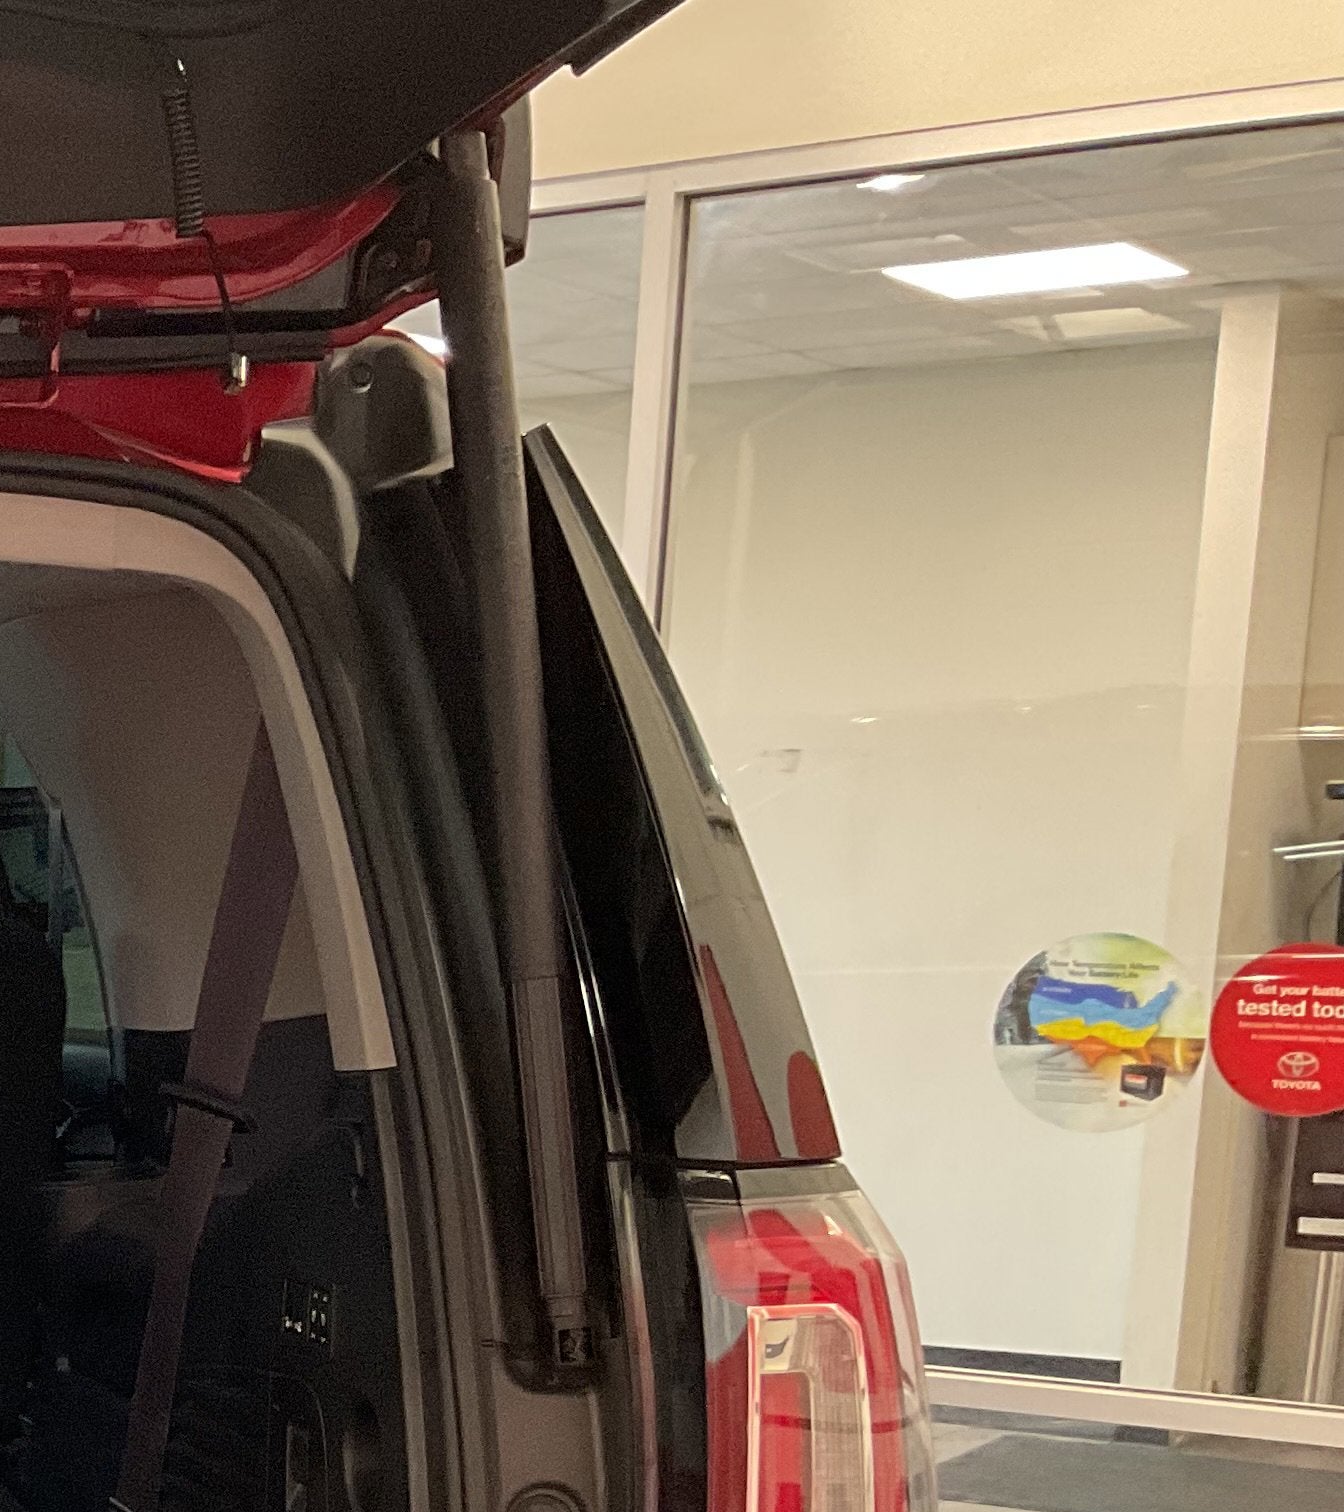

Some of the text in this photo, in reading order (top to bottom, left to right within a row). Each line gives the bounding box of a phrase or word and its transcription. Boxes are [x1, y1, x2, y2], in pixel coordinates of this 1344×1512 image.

[1253, 984, 1277, 995] Get
[1279, 986, 1311, 998] your
[1237, 998, 1307, 1017] tested
[1271, 1079, 1322, 1091] TOYOTA
